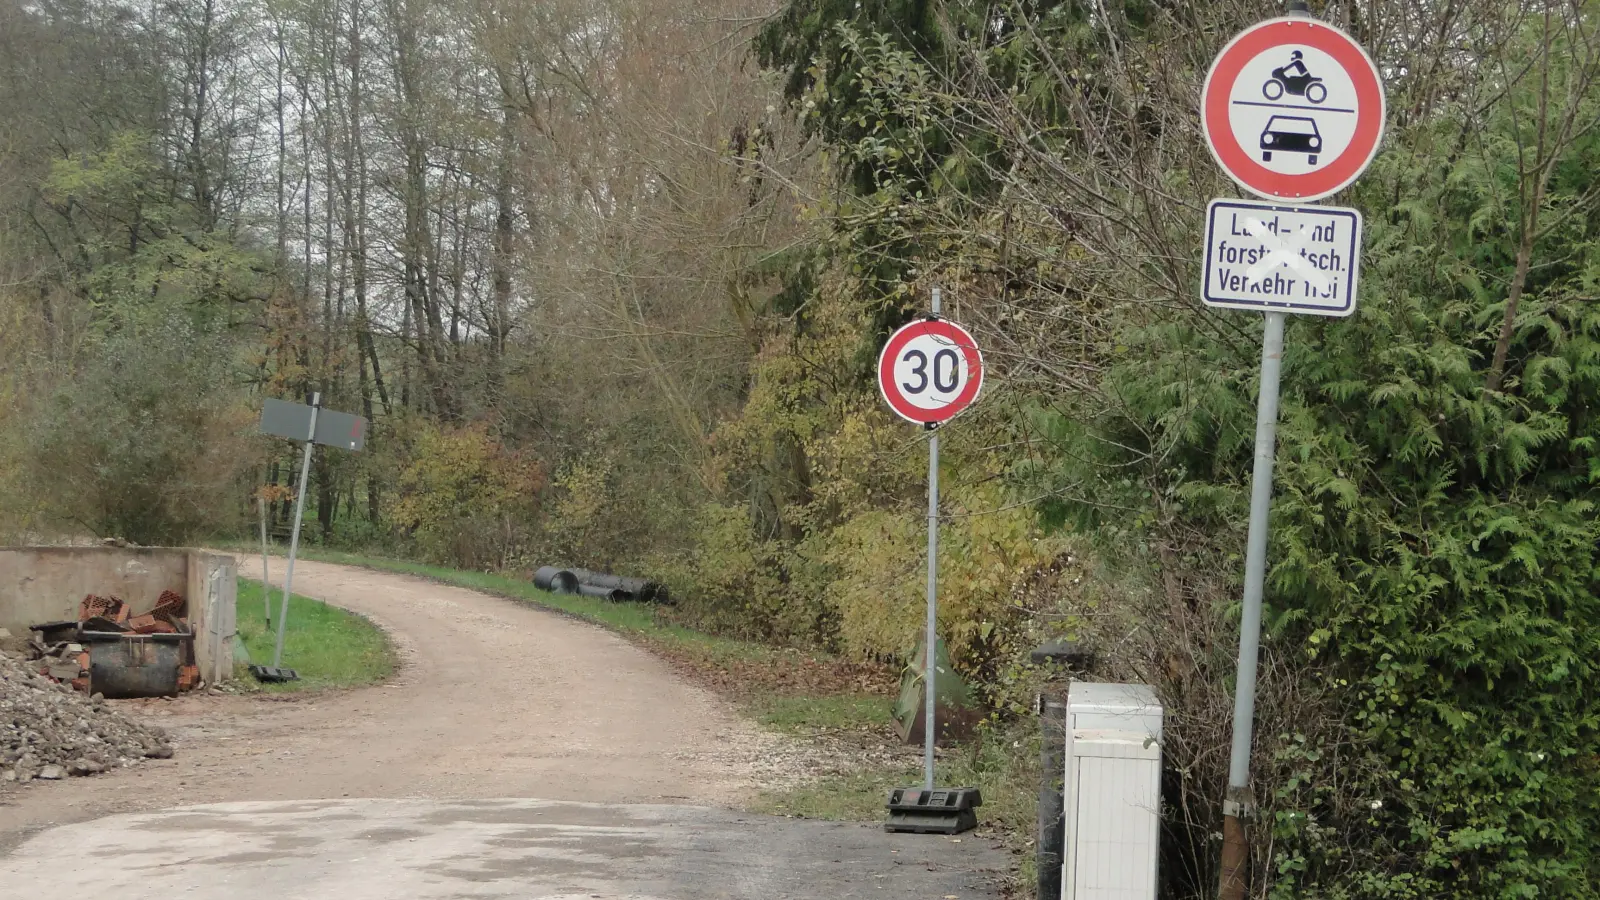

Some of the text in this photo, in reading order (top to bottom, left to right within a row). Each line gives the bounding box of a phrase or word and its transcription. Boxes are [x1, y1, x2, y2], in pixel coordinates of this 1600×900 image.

[1231, 213, 1336, 243] Ld- nd
[1218, 240, 1346, 272] forsttsch.
[902, 348, 960, 395] 30
